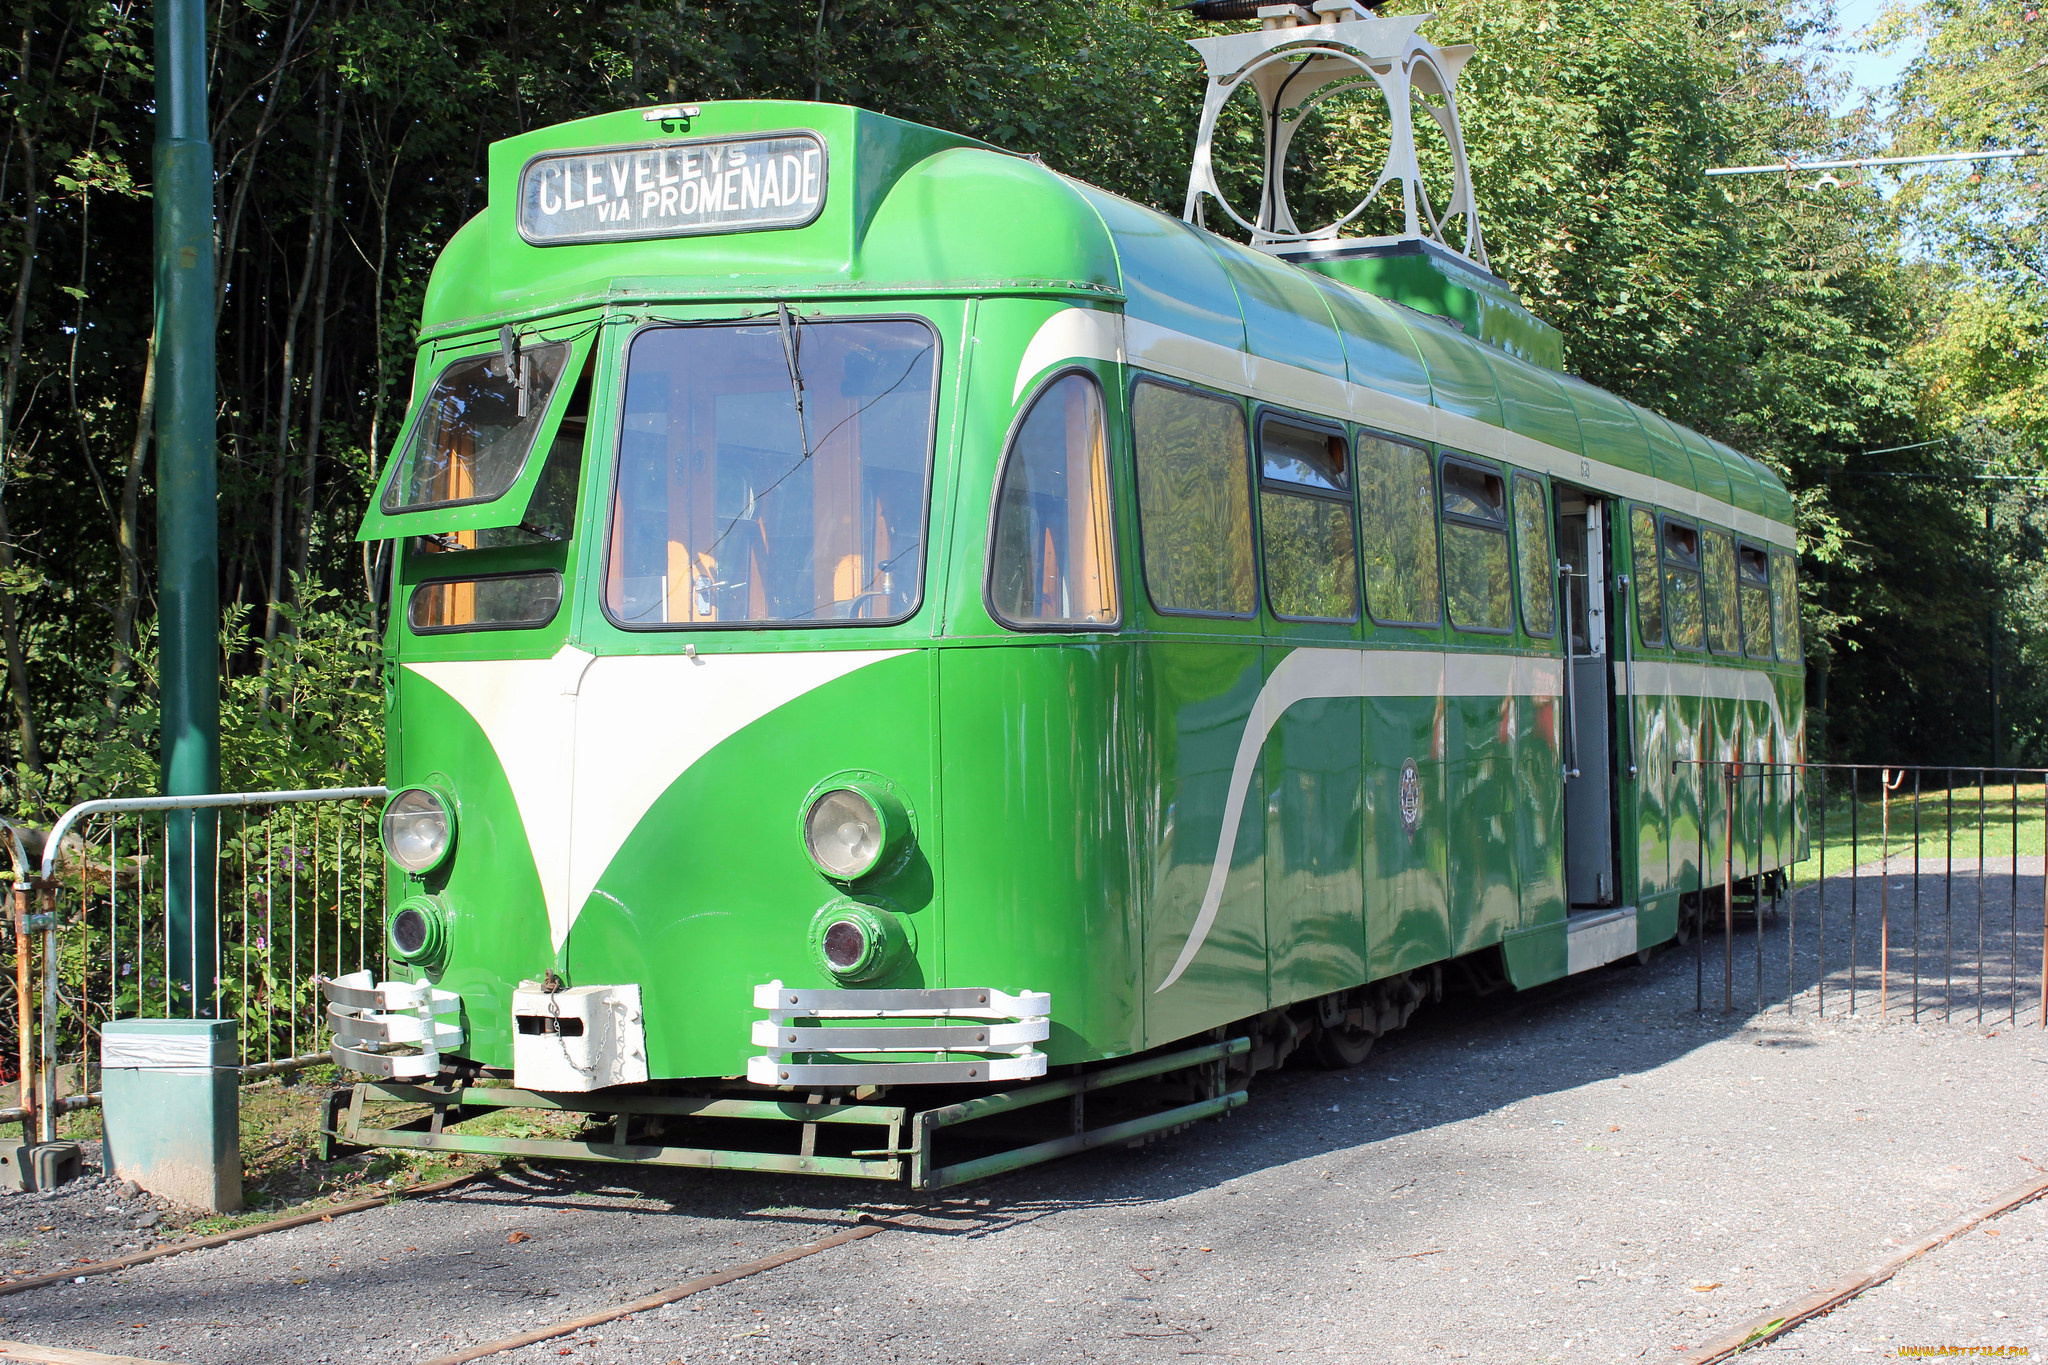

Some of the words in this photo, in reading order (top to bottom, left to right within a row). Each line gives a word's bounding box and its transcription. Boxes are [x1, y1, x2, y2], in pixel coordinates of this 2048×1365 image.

[540, 144, 747, 216] CLEVELEYS
[597, 202, 631, 223] VIA
[642, 148, 820, 219] PROMENADE
